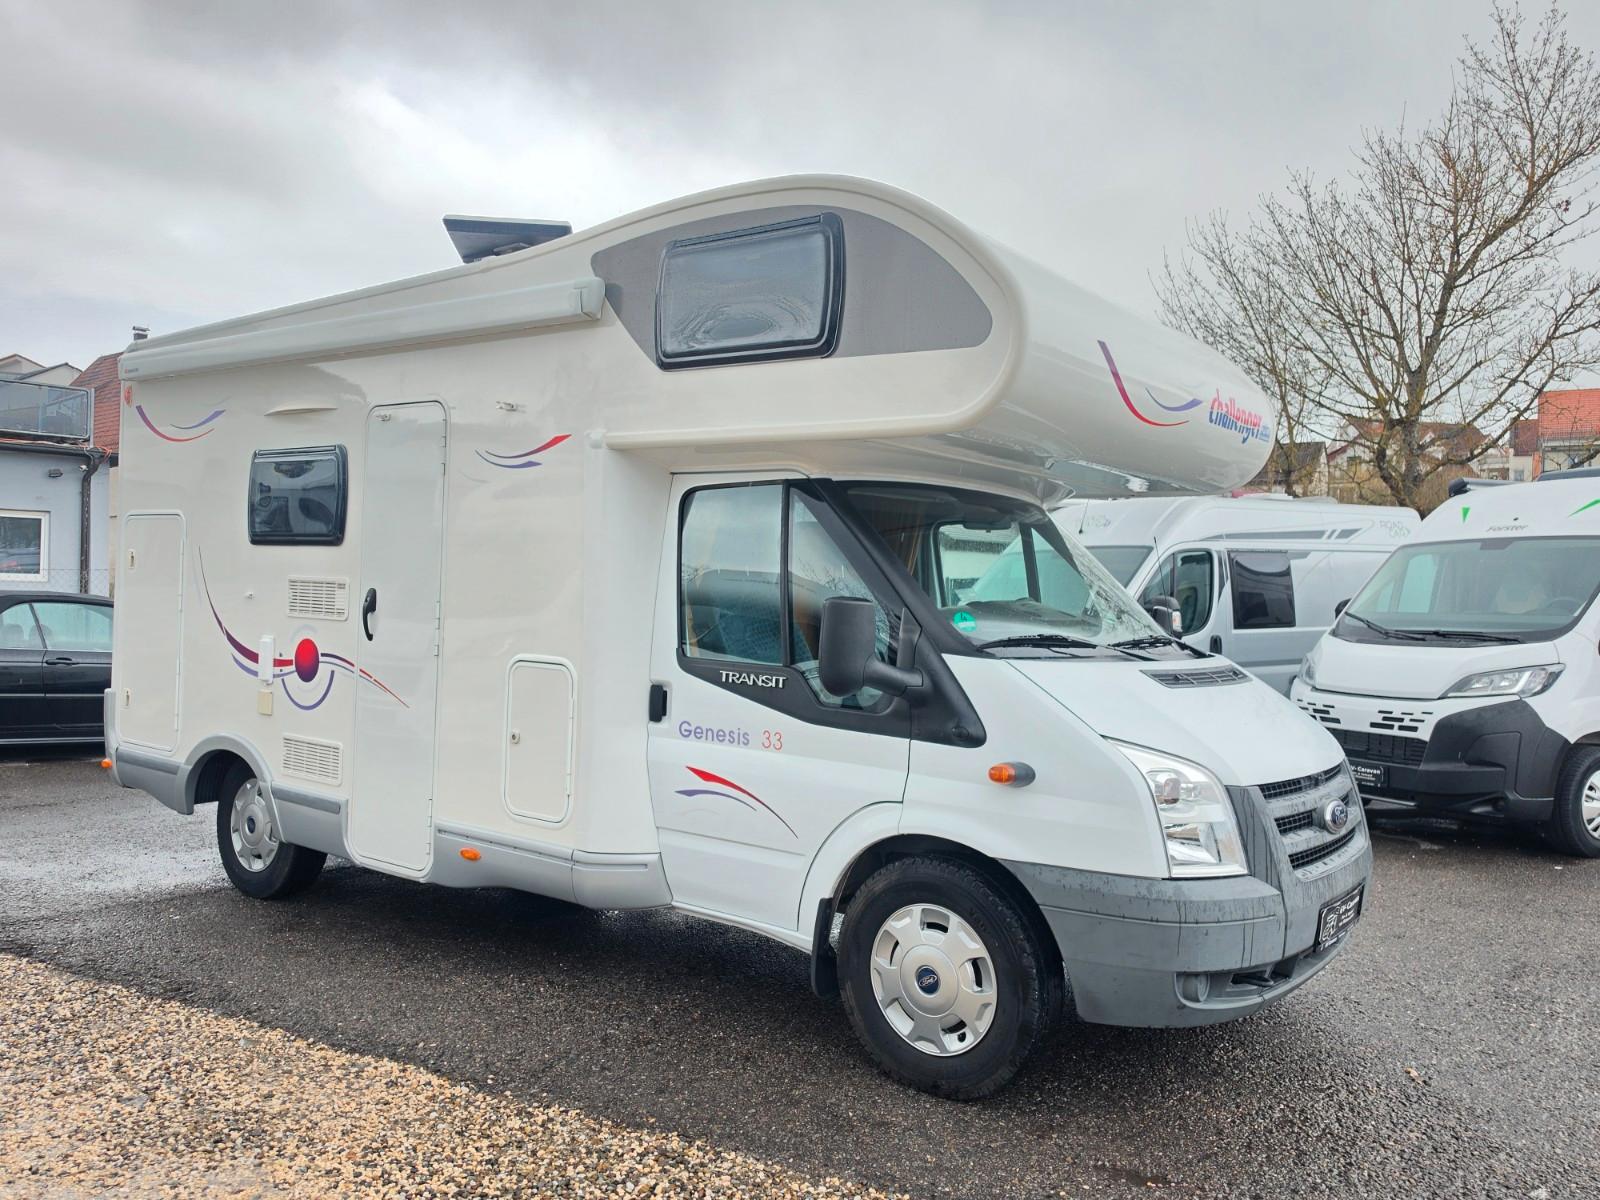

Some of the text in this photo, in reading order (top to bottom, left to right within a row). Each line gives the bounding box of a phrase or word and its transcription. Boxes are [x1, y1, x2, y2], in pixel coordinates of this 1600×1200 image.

[720, 670, 787, 689] TRANSIT
[679, 720, 784, 751] Genesis 33
